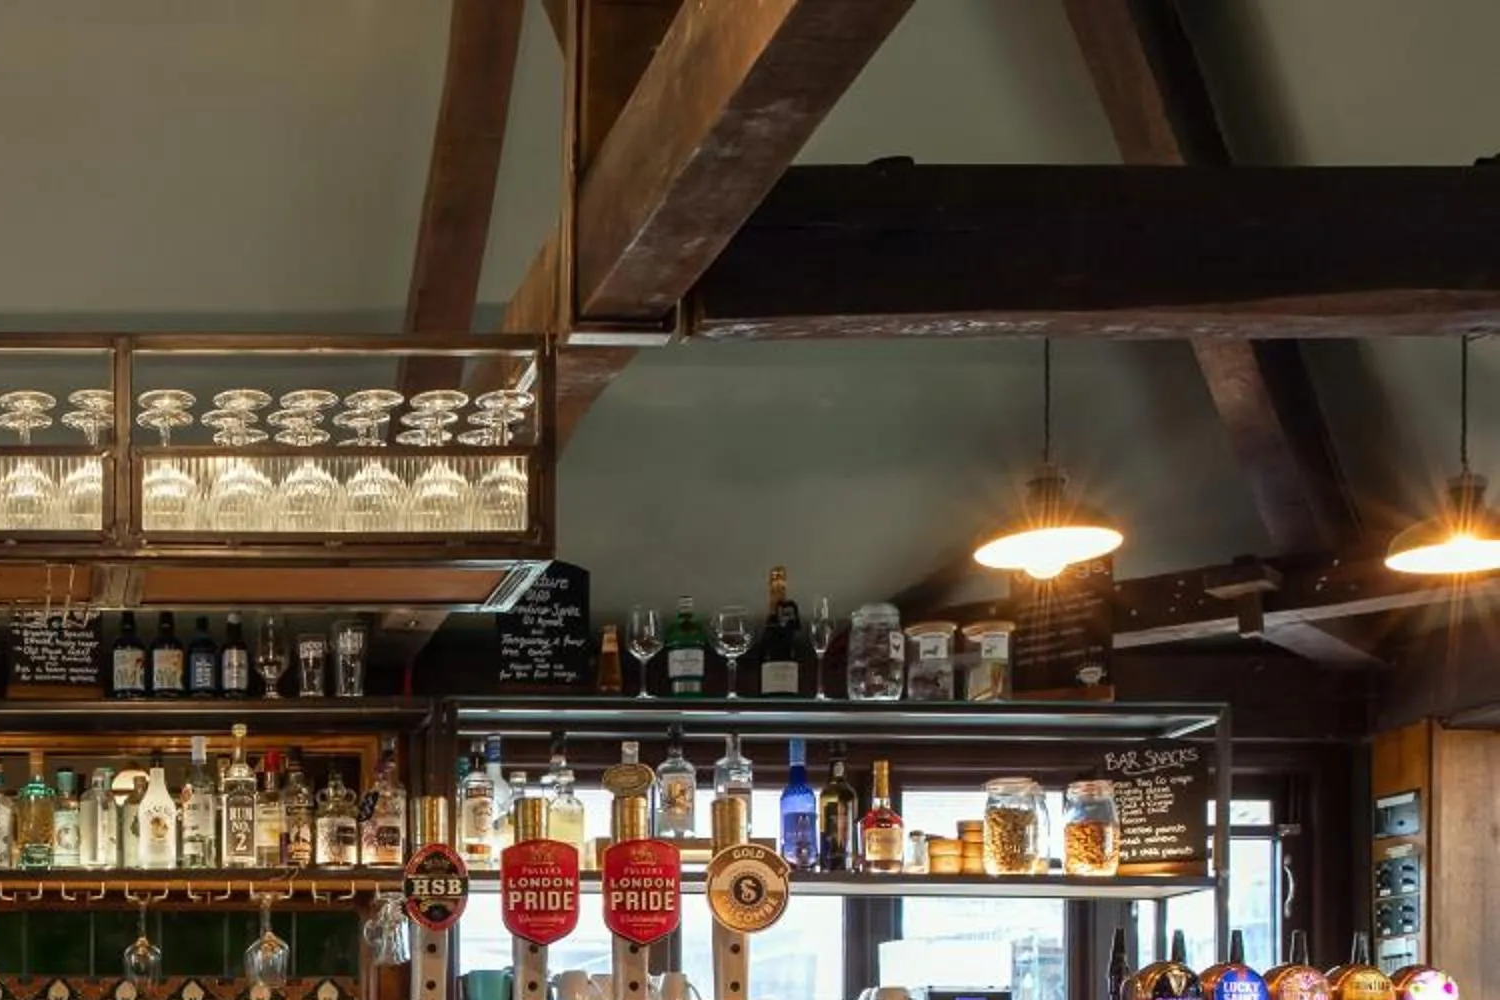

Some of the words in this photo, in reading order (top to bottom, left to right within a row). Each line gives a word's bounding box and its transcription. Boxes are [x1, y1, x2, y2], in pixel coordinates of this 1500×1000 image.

[1105, 751, 1141, 770] BAR
[1144, 747, 1200, 767] SNACKS
[732, 847, 766, 859] GOLD
[411, 879, 462, 895] HSB
[509, 877, 575, 889] LONDON
[610, 877, 675, 889] LONDON
[509, 891, 575, 911] PRIDE
[611, 891, 675, 911] PRIDE
[1223, 981, 1262, 993] LUCKY
